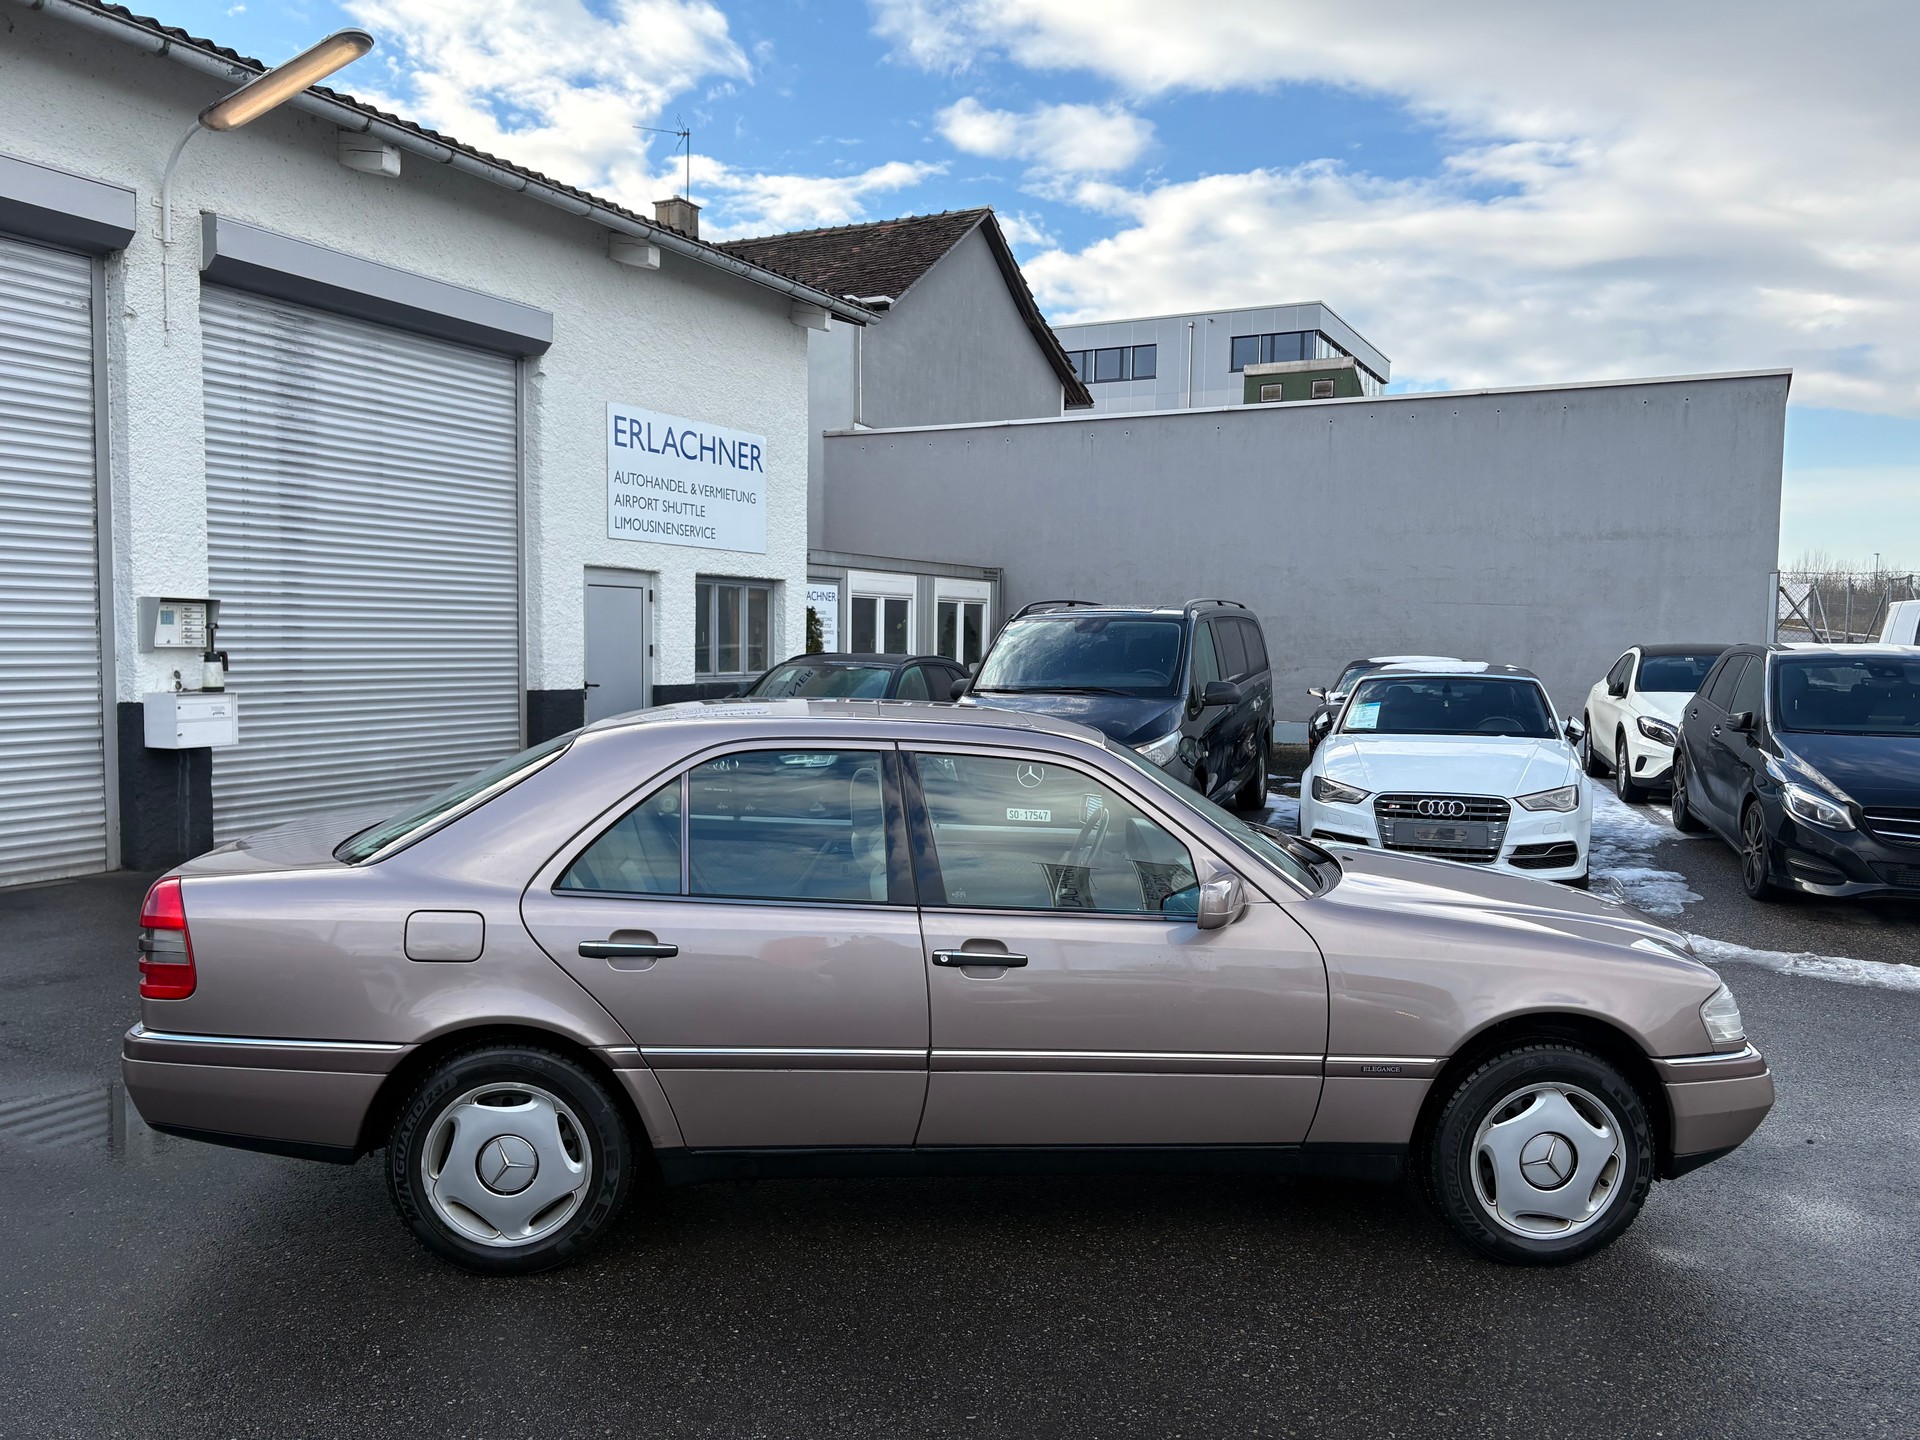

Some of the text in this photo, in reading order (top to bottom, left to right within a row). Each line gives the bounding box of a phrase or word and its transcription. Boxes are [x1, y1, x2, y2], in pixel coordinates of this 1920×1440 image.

[614, 415, 764, 473] ERLACHNER
[614, 471, 757, 504] AUTOHANDEL & VERMIETUNG
[614, 493, 706, 518] AIRPORT SHUTTLE
[614, 516, 716, 540] LIMOUSINENSERVICE
